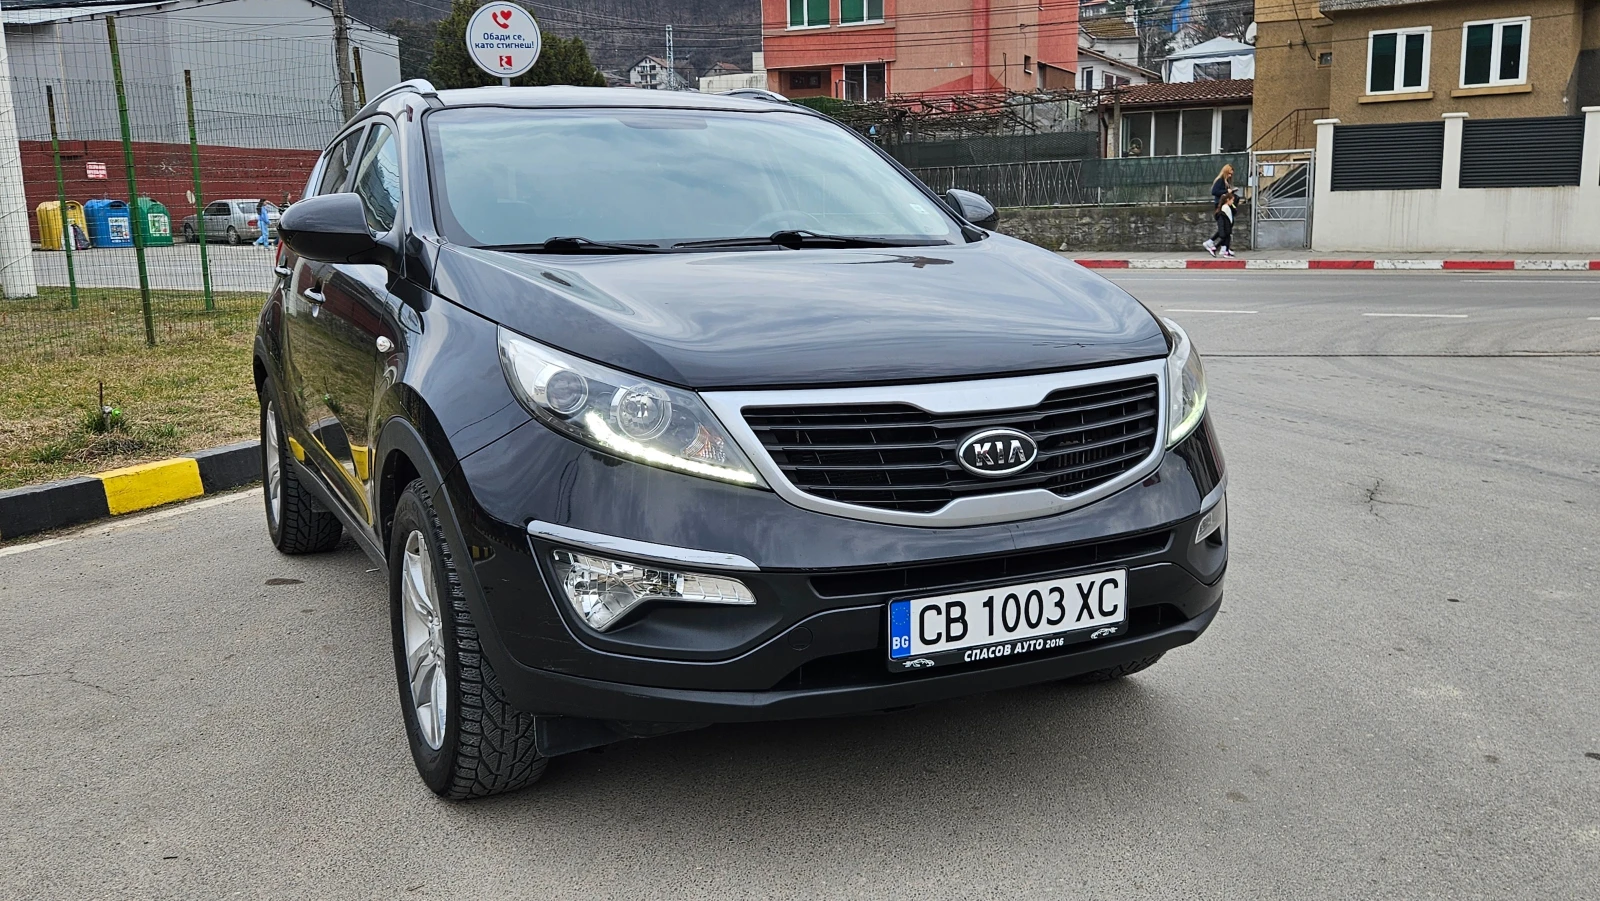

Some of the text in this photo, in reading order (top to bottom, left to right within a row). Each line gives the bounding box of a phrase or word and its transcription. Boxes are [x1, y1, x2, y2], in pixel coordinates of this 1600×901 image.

[483, 32, 510, 41] Обади
[496, 41, 534, 49] стигнеш!
[973, 440, 1026, 466] KIA
[918, 577, 1119, 646] CB 1003 XC
[892, 635, 909, 650] BG
[964, 637, 1064, 662] СПАСОВ АУТО 2016
